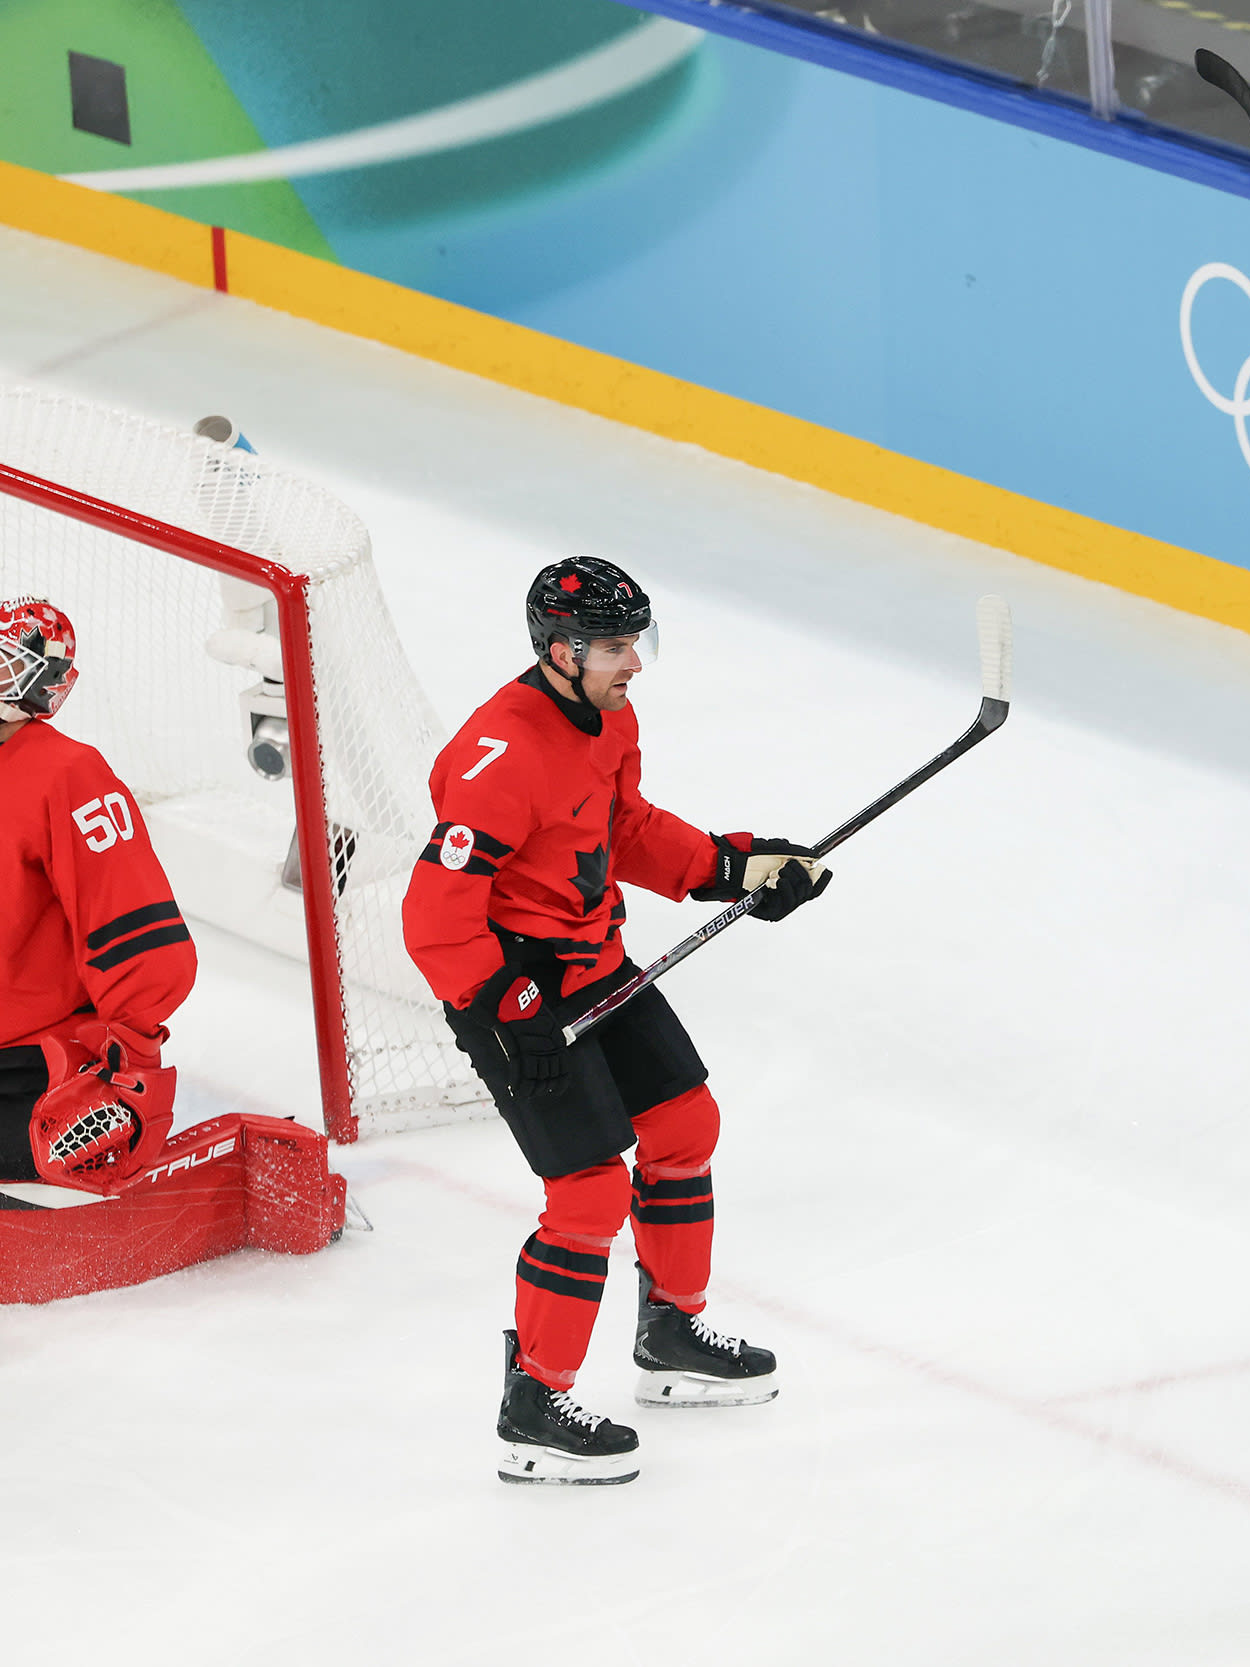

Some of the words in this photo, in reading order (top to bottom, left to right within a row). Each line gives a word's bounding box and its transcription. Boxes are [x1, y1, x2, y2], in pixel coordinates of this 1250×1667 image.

[617, 582, 633, 598] 7
[461, 736, 509, 780] 7
[71, 791, 134, 853] 50
[723, 855, 731, 881] MACH
[144, 1137, 236, 1183] TRUE
